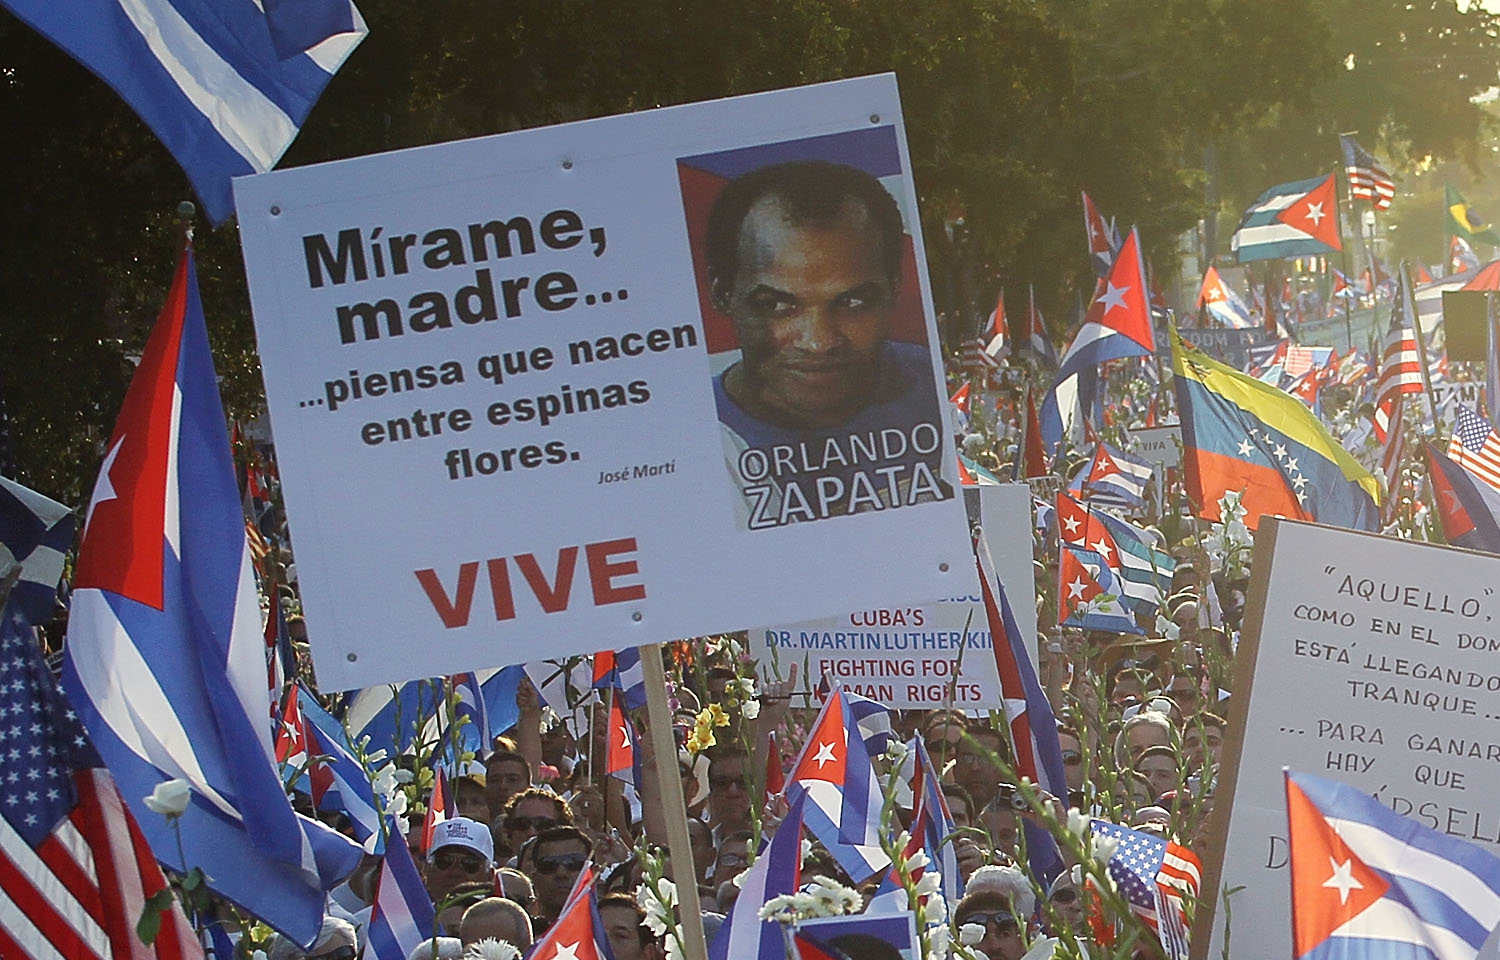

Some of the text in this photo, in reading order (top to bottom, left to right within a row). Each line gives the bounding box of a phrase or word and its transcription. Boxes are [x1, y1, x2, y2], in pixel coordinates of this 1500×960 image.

[301, 206, 608, 289] Mírame,
[336, 269, 631, 344] madre...
[299, 322, 699, 413] ...piensa que nacen
[361, 376, 651, 445] entre espinas
[444, 441, 582, 481] flores.
[737, 421, 944, 487] ORLANDO
[1142, 440, 1167, 452] VIVA
[598, 460, 677, 486] José Martí
[745, 458, 947, 531] ZAPATA
[414, 537, 647, 630] VIVE
[850, 608, 925, 627] CUBA'S
[1294, 604, 1355, 628] COMO
[1371, 617, 1402, 636] EN
[1411, 624, 1440, 647] EL
[967, 631, 995, 650] KI
[1295, 640, 1359, 665] ESTÁ
[820, 659, 963, 677] FIGHTING FOR
[907, 684, 982, 702] RIGHTS
[1325, 751, 1467, 791] HAY QUE
